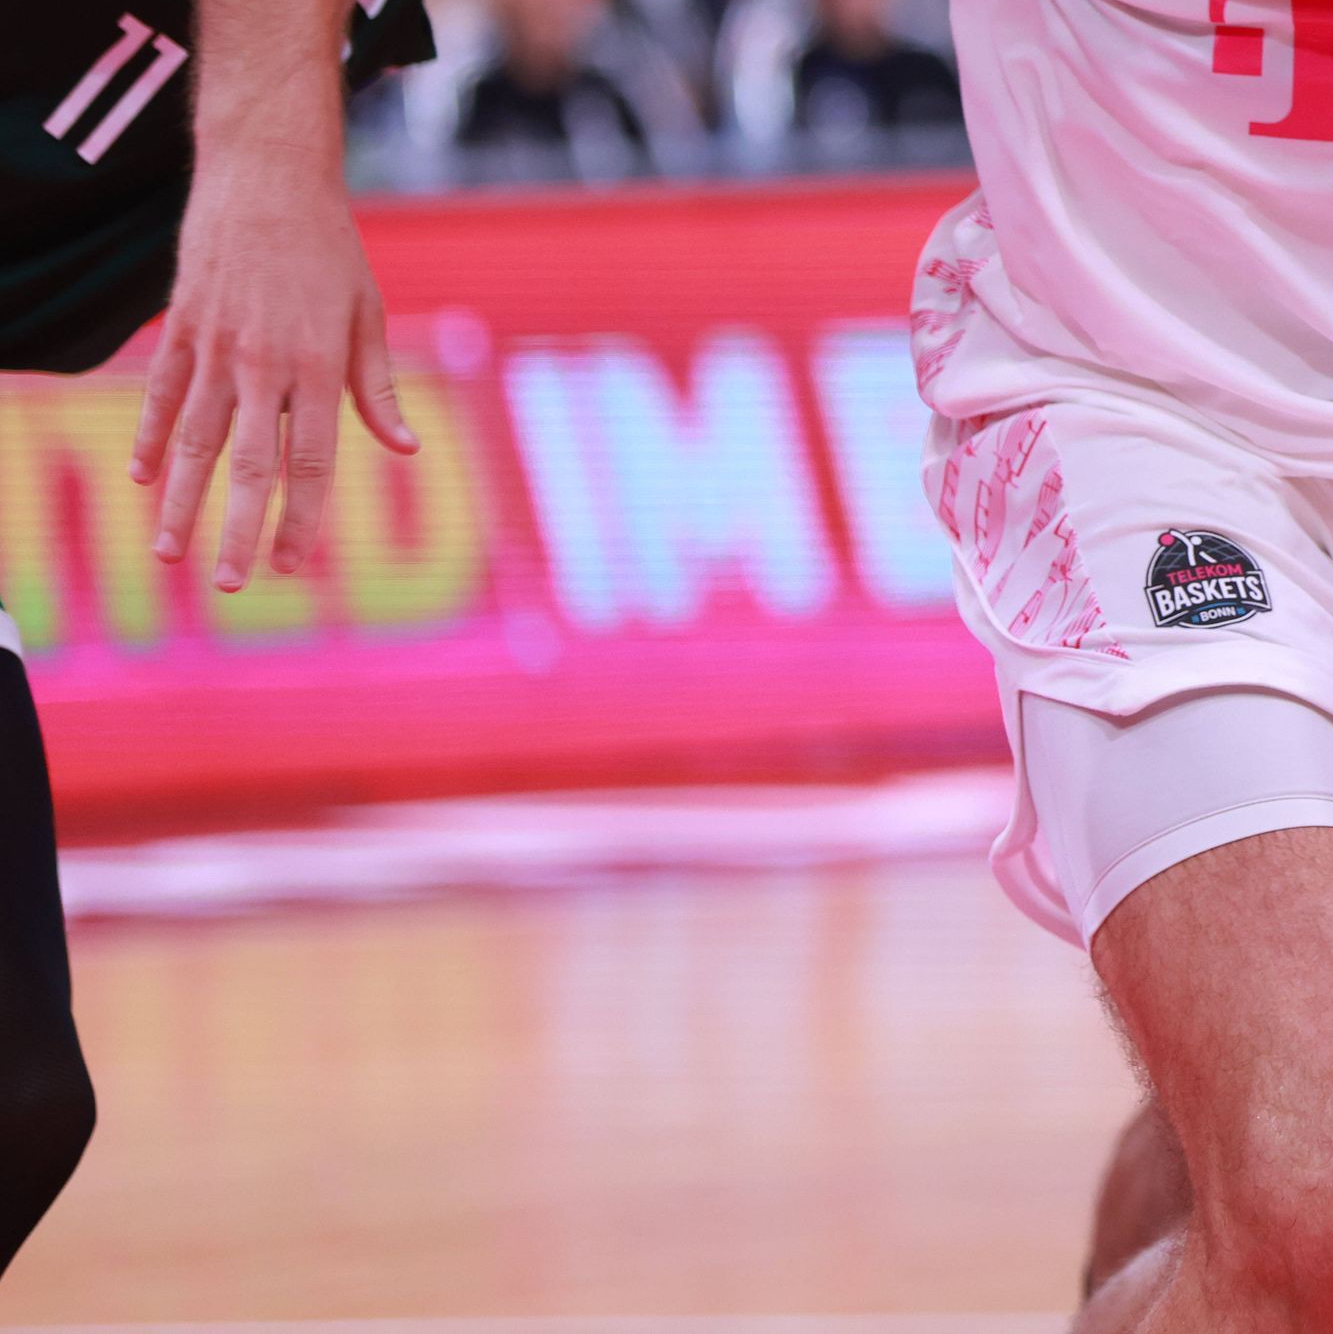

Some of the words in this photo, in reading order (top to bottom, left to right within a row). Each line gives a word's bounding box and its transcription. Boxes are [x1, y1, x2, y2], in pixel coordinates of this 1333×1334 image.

[42, 11, 190, 166] 11
[1166, 563, 1243, 585] TELEKOM
[1154, 575, 1263, 619] BASKETS
[1199, 606, 1237, 622] BONN
